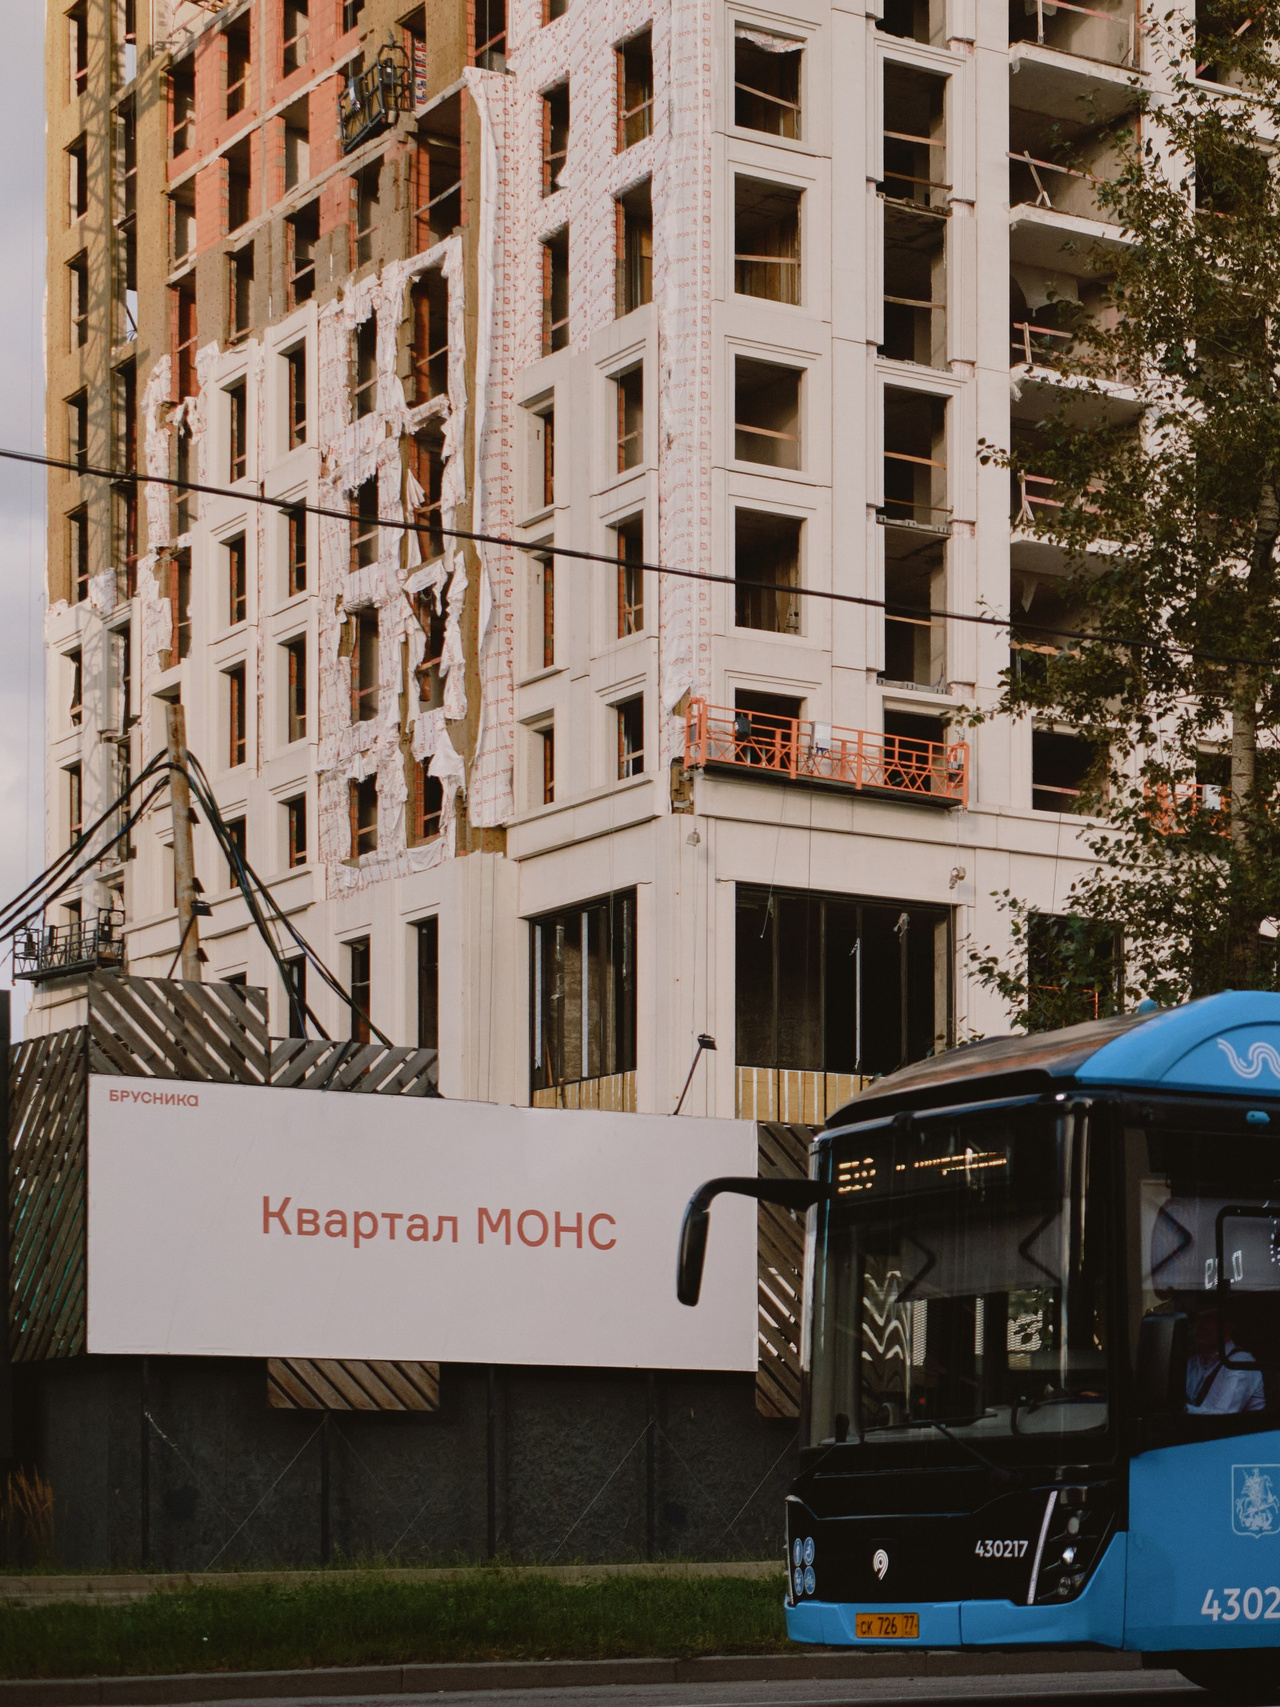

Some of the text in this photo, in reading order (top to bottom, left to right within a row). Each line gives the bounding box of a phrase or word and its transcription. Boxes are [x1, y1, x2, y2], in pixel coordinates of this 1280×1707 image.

[262, 1195, 617, 1251] Квартал МОНС
[975, 1539, 1029, 1558] 430217
[877, 1616, 898, 1635] 726
[904, 1615, 915, 1630] 77
